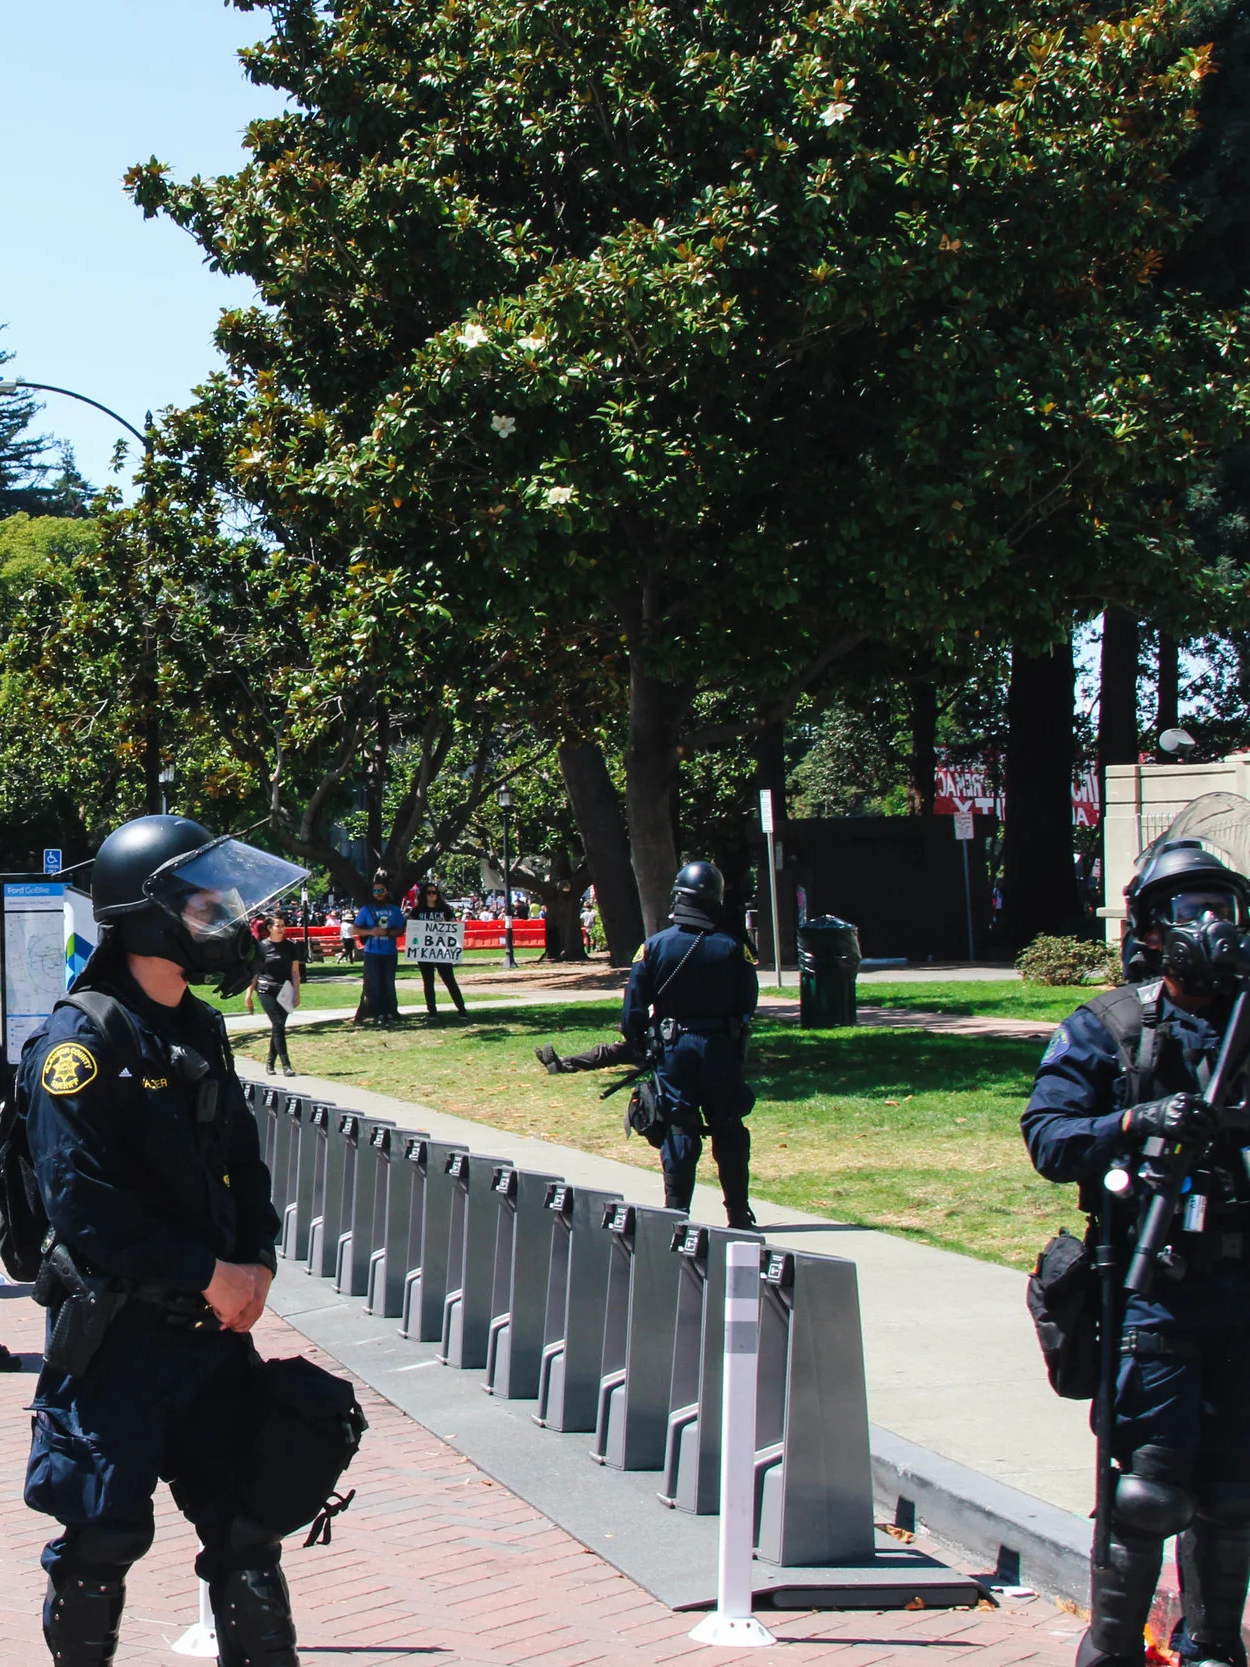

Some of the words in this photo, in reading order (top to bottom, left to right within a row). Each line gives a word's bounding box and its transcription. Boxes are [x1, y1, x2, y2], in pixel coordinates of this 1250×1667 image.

[7, 886, 24, 894] Ford
[25, 886, 50, 894] GoBike
[425, 922, 458, 933] NAZIS
[424, 935, 457, 947] BAD
[407, 947, 462, 960] M'KAAAY?
[70, 1047, 93, 1069] COUNTY
[50, 1077, 79, 1090] SHERIFF
